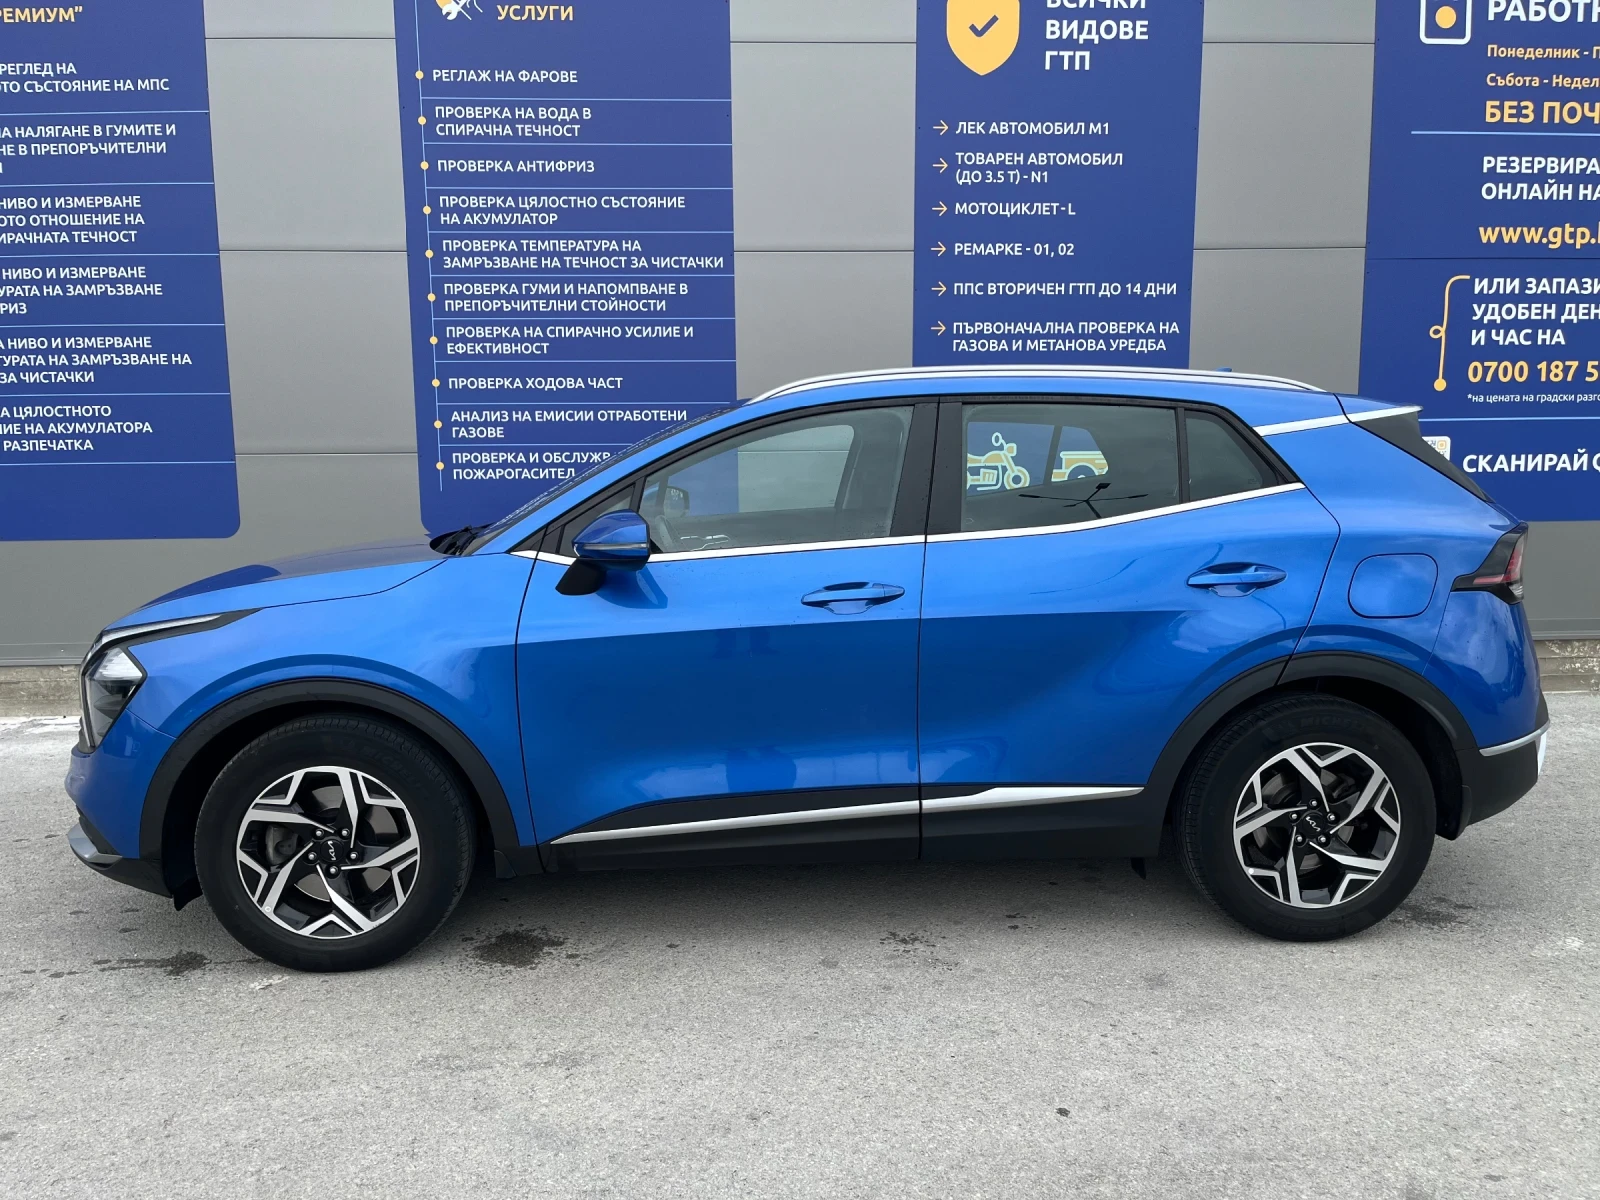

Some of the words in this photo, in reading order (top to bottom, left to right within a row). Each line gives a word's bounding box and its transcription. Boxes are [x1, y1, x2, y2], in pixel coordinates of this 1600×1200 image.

[0, 6, 82, 22] ЕМИУМ”
[497, 5, 573, 20] УСЛУГИ
[1046, 20, 1148, 44] ВИДОВЕ
[1488, 45, 1580, 60] Понеделник
[1045, 51, 1090, 70] ГТП
[57, 63, 76, 74] НА
[433, 70, 491, 81] РЕГЛАЖ
[495, 70, 515, 81] НА
[518, 70, 577, 82] ФАРОВЕ
[1487, 73, 1539, 86] Събота
[0, 81, 20, 92] ТО
[24, 80, 110, 92] СЪСТОЯНИЕ
[114, 80, 134, 91] НА
[138, 79, 169, 90] МПС
[435, 107, 512, 118] ПРОВЕРКА
[515, 107, 535, 118] НА
[539, 108, 579, 121] ВОДА
[583, 108, 591, 119] В
[1486, 101, 1534, 123] БЕЗ
[1543, 102, 1600, 124] ПОЧ
[15, 126, 90, 137] НАЛЯГАНЕ
[94, 125, 102, 136] В
[106, 124, 162, 136] ГУМИТЕ
[166, 124, 175, 135] И
[436, 124, 513, 136] СПИРАЧНА
[516, 125, 580, 136] ТЕЧНОСТ
[956, 122, 985, 134] ЛЕК
[989, 122, 1084, 134] АВТОМОБИЛ
[1089, 123, 1108, 134] М1
[19, 144, 27, 155] В
[31, 142, 166, 155] ПРЕПОРЪЧИТЕЛНИ
[956, 153, 1023, 164] ТОВАРЕН
[1028, 153, 1122, 165] АВТОМОБИЛ
[438, 160, 513, 171] ПРОВЕРКА
[517, 160, 594, 172] АНТИФРИЗ
[1483, 157, 1600, 174] РЕЗЕРВИРА
[956, 169, 981, 185] (ДО
[985, 171, 1004, 182] 3.5
[1008, 169, 1020, 184] Т)
[1031, 171, 1047, 182] N1
[1482, 179, 1572, 200] ОНЛАЙН
[42, 197, 51, 208] И
[55, 196, 141, 208] ИЗМЕРВАНЕ
[440, 196, 515, 207] ПРОВЕРКА
[519, 197, 597, 210] ЦЯЛОСТНО
[601, 197, 685, 208] СЪСТОЯНИЕ
[30, 214, 121, 226] ОТНОШЕНИЕ
[125, 214, 145, 224] НА
[441, 213, 460, 224] НА
[464, 213, 557, 224] АКУМУЛАТОР
[72, 231, 137, 242] ТЕЧНОСТ
[1479, 222, 1600, 248] www.gtp.
[443, 240, 517, 251] ПРОВЕРКА
[521, 240, 619, 251] ТЕМПЕРАТУРА
[623, 240, 641, 251] НА
[955, 243, 1022, 255] РЕМАРКЕ
[444, 257, 538, 268] ЗАМРЪЗВАНЕ
[542, 257, 561, 268] НА
[564, 257, 627, 268] ТЕЧНОСТ
[631, 257, 648, 268] ЗА
[652, 257, 723, 268] ЧИСТАЧКИ
[2, 268, 42, 279] НИВО
[46, 268, 56, 278] И
[60, 267, 146, 278] ИЗМЕРВАНЕ
[43, 285, 63, 296] НА
[66, 284, 162, 295] ЗАМРЪЗВАНЕ
[444, 284, 519, 294] ПРОВЕРКА
[522, 284, 560, 294] ГУМИ
[565, 284, 573, 294] И
[578, 284, 676, 294] НАПОМПВАНЕ
[680, 284, 688, 294] В
[954, 283, 983, 295] ППС
[988, 283, 1064, 294] ВТОРИЧЕН
[1070, 283, 1095, 294] ГТП
[1099, 283, 1121, 297] ДО
[1126, 283, 1141, 294] 14
[1144, 283, 1176, 297] ДНИ
[1475, 278, 1519, 294] ИЛИ
[445, 300, 577, 311] ПРЕПОРЪЧИТЕЛНИ
[581, 297, 665, 311] СТОЙНОСТИ
[1472, 304, 1556, 323] УДОБЕН
[447, 327, 520, 337] ПРОВЕРКА
[524, 327, 543, 337] НА
[547, 327, 621, 337] СПИРАЧНО
[625, 327, 680, 337] УСИЛИЕ
[684, 327, 693, 337] И
[954, 322, 1074, 334] ПЪРВОНАЧАЛНА
[1079, 322, 1155, 333] ПРОВЕРКА
[1160, 322, 1179, 333] НА
[8, 338, 47, 349] НИВО
[52, 338, 61, 348] И
[65, 337, 152, 348] ИЗМЕРВАНЕ
[1472, 330, 1485, 345] И
[1492, 329, 1532, 345] ЧАС
[1538, 329, 1565, 344] НА
[447, 343, 549, 354] ЕФЕКТИВНОСТ
[953, 340, 1008, 351] ГАЗОВА
[1013, 340, 1022, 351] И
[1027, 339, 1106, 351] МЕТАНОВА
[1110, 339, 1166, 353] УРЕДБА
[49, 355, 68, 365] НА
[72, 354, 168, 365] ЗАМРЪЗВАНЕ
[172, 354, 192, 364] НА
[20, 372, 94, 383] ЧИСТАЧКИ
[1468, 361, 1528, 382] 0700
[1537, 361, 1578, 381] 187
[449, 378, 523, 389] ПРОВЕРКА
[526, 378, 585, 391] ХОДОВА
[588, 378, 623, 388] ЧАСТ
[1486, 394, 1521, 404] цената
[1522, 394, 1534, 402] на
[1536, 394, 1575, 404] градски
[14, 406, 111, 419] ЦЯЛОСТНОТО
[451, 411, 509, 421] АНАЛИЗ
[513, 411, 531, 421] НА
[535, 411, 593, 421] ЕМИСИИ
[598, 410, 686, 421] ОТРАБОТЕНИ
[25, 423, 44, 434] НА
[48, 422, 152, 433] АКУМУЛАТОРА
[453, 427, 504, 438] ГАЗОВЕ
[4, 440, 93, 451] РАЗПЕЧАТКА
[453, 453, 526, 463] ПРОВЕРКА
[530, 453, 538, 463] И
[1463, 449, 1588, 472] СКАНИРАЙ
